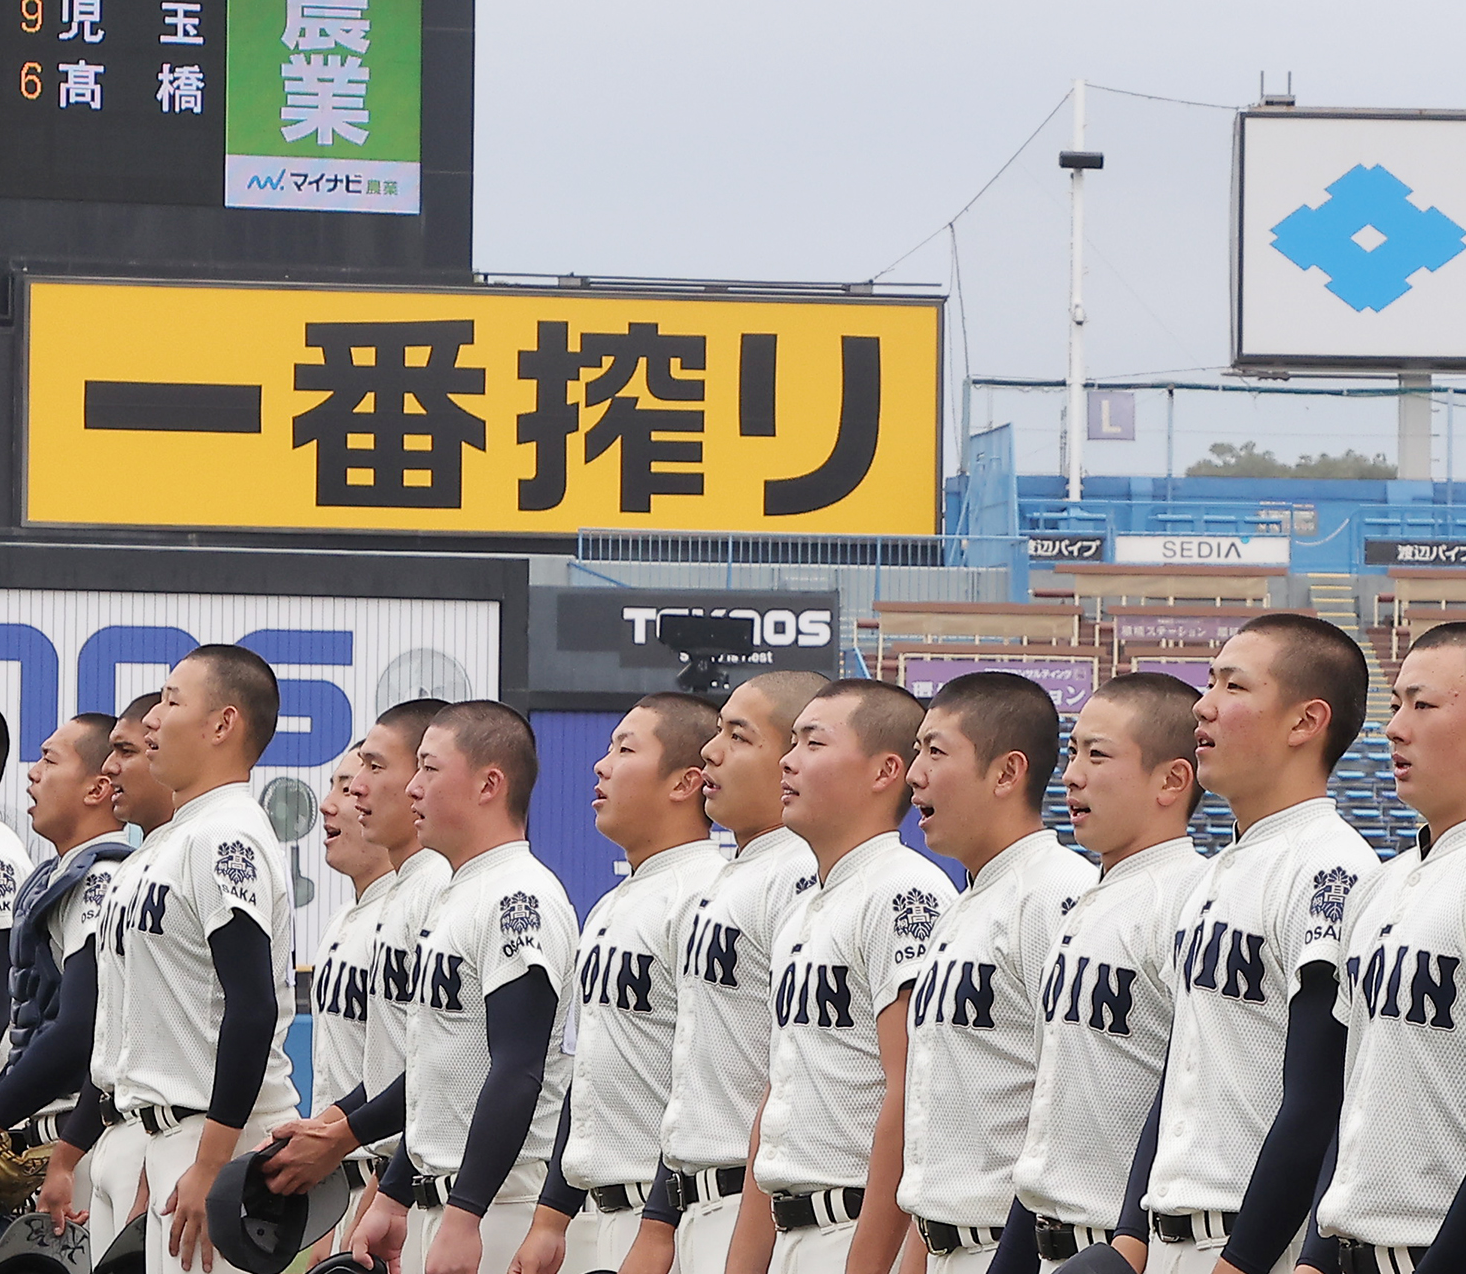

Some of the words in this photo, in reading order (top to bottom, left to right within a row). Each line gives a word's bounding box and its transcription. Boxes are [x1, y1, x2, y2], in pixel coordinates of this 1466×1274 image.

[21, 62, 41, 99] 6
[290, 171, 363, 195] マイナビ
[84, 319, 883, 517] 一番搾り
[1100, 399, 1122, 433] L
[1162, 537, 1243, 560] SEDIA
[622, 607, 832, 647] TNOS
